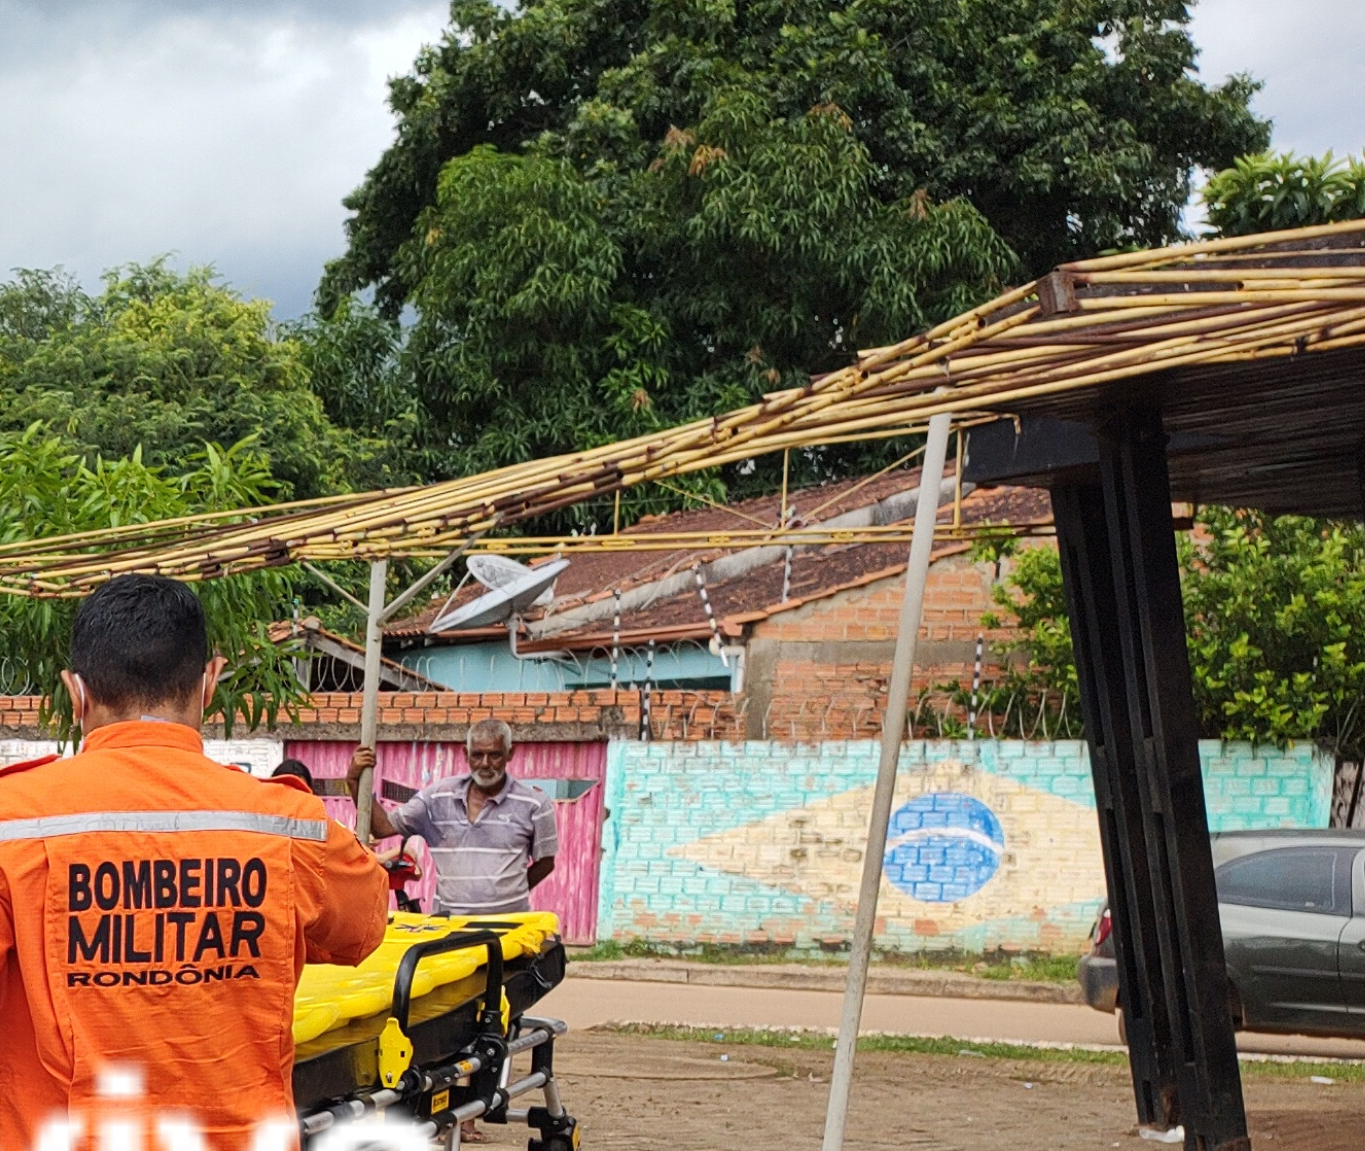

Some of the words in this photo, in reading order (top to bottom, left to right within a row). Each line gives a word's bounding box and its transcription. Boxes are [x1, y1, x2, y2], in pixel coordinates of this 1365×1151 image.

[69, 857, 267, 912] BOMBEIRO
[67, 910, 266, 964] MILITAR
[67, 963, 260, 987] RONDÔNIA
